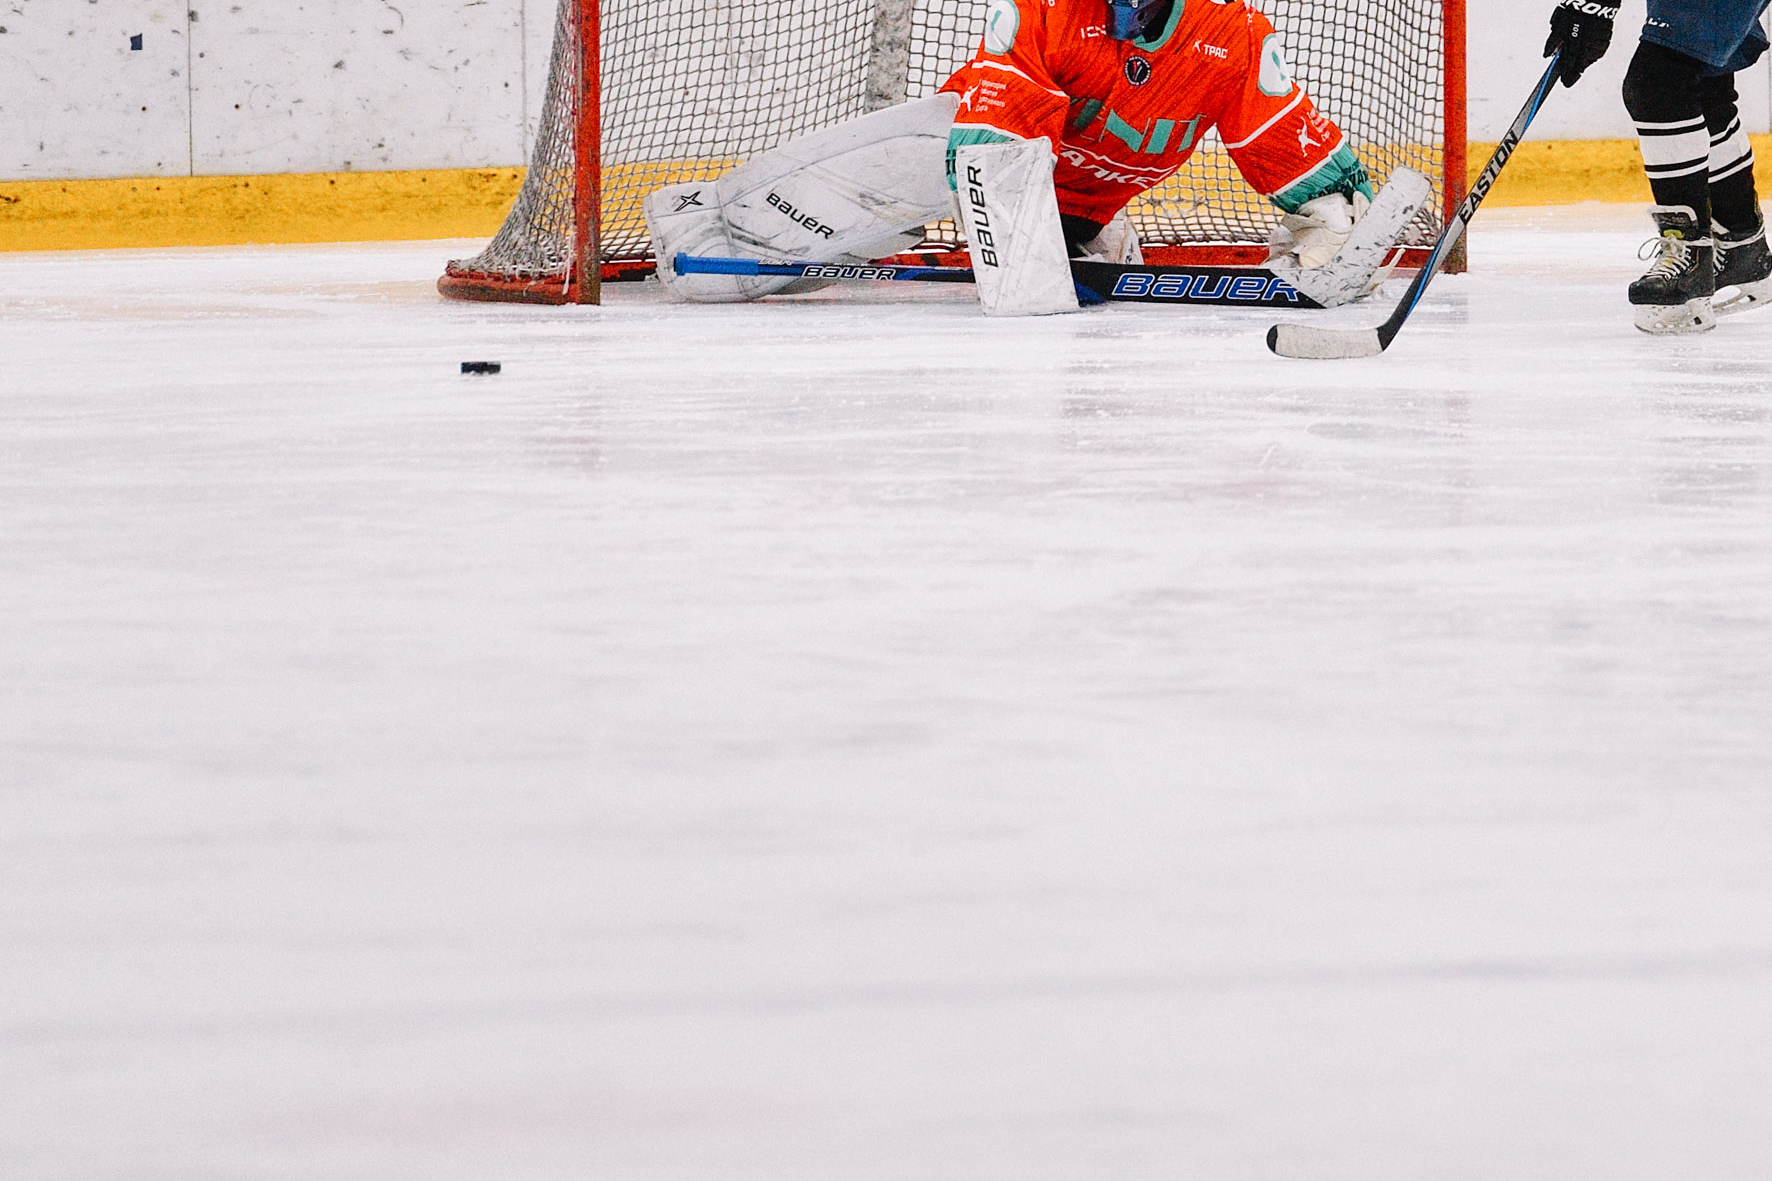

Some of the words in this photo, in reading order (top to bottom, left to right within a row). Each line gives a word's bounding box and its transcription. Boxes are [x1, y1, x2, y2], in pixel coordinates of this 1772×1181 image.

[1458, 129, 1520, 225] EASTON
[766, 191, 836, 240] BAUER
[967, 165, 999, 268] BAUER
[801, 265, 897, 281] BAUER
[1111, 272, 1300, 302] BAUER
